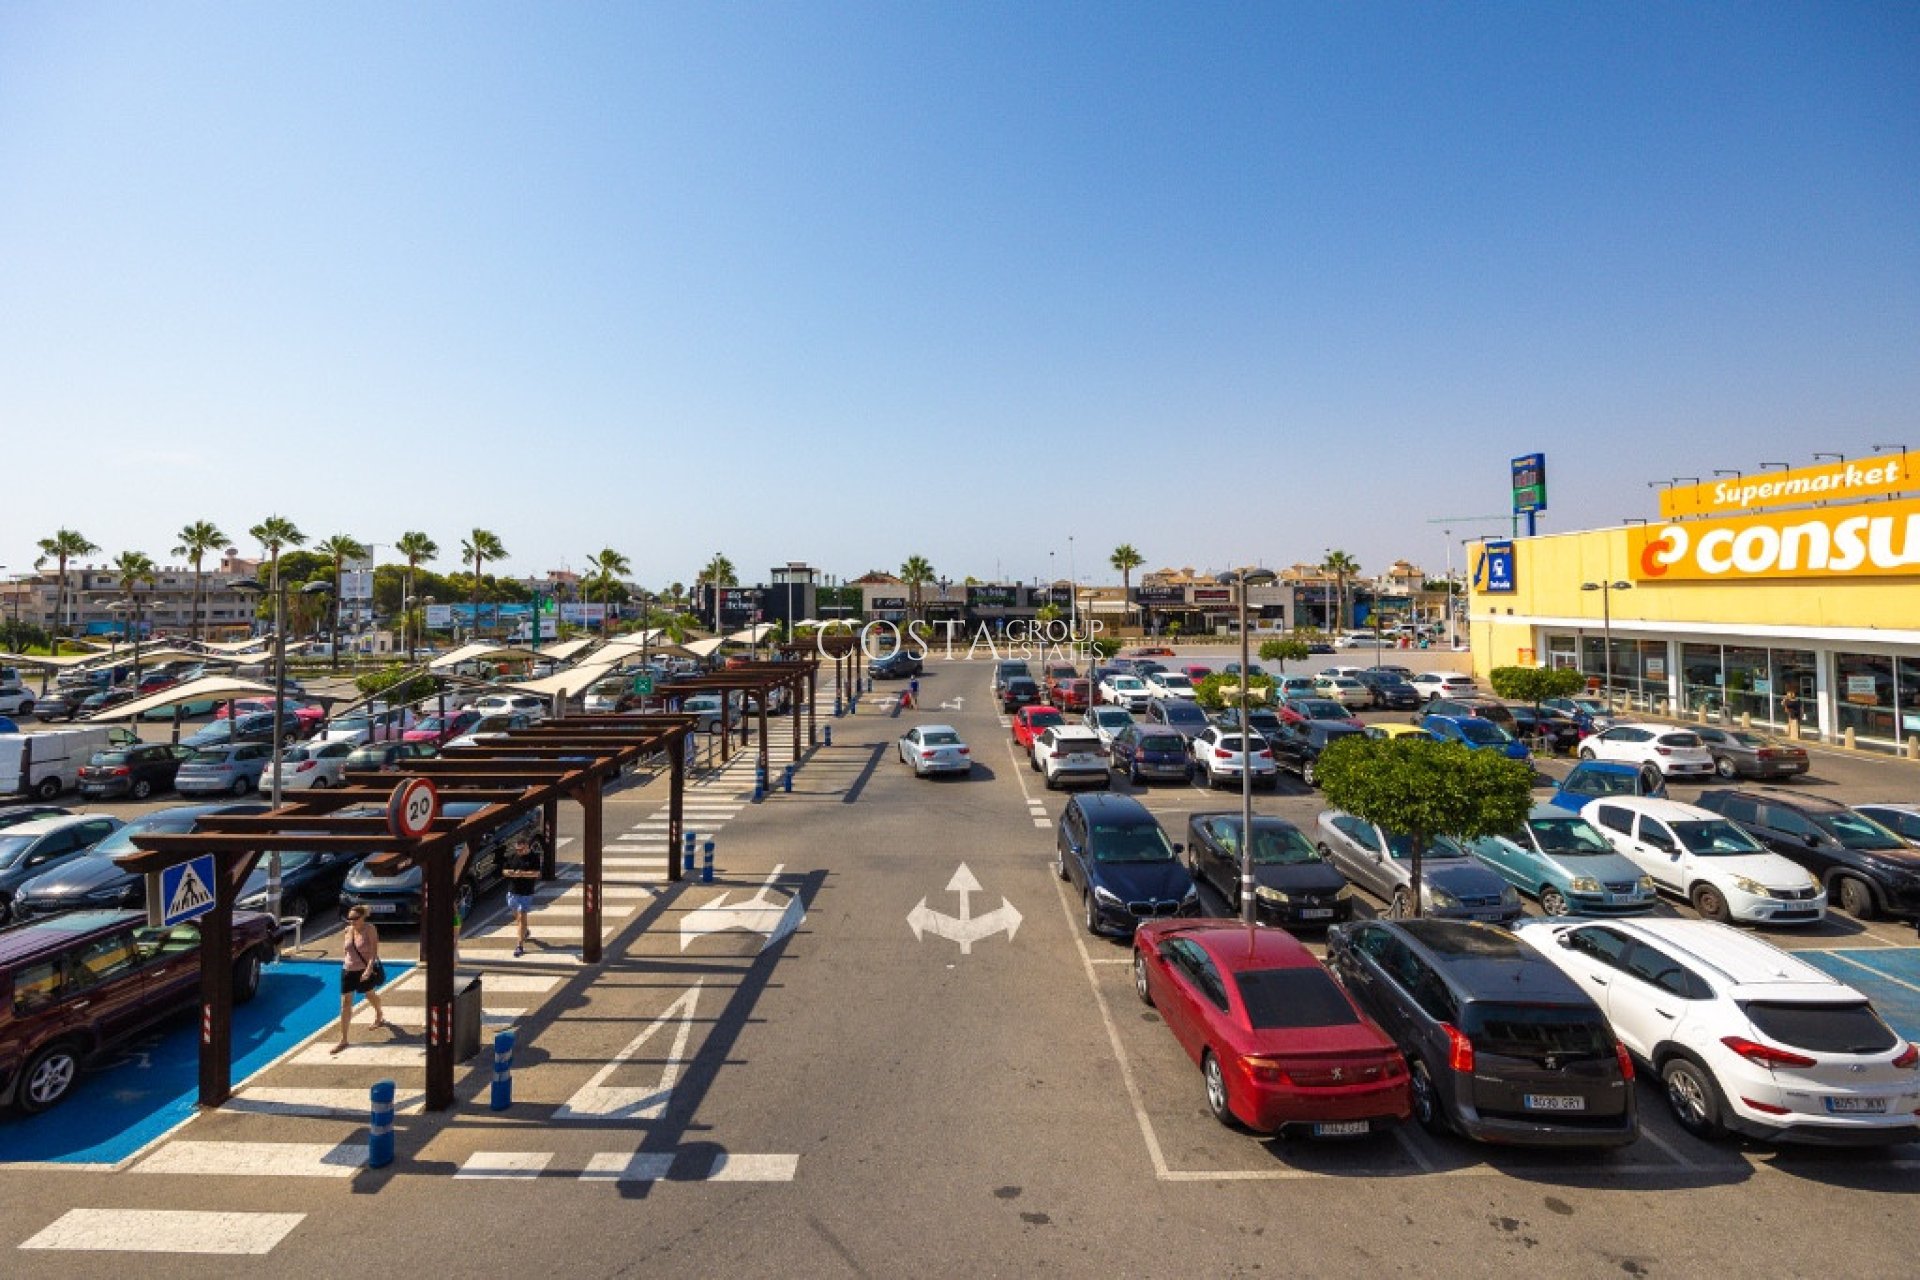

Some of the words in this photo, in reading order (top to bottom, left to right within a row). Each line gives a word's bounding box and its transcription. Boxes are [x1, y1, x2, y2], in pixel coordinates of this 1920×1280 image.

[1713, 461, 1900, 507] Supermarket
[1695, 513, 1920, 575] consu
[410, 797, 430, 821] 20
